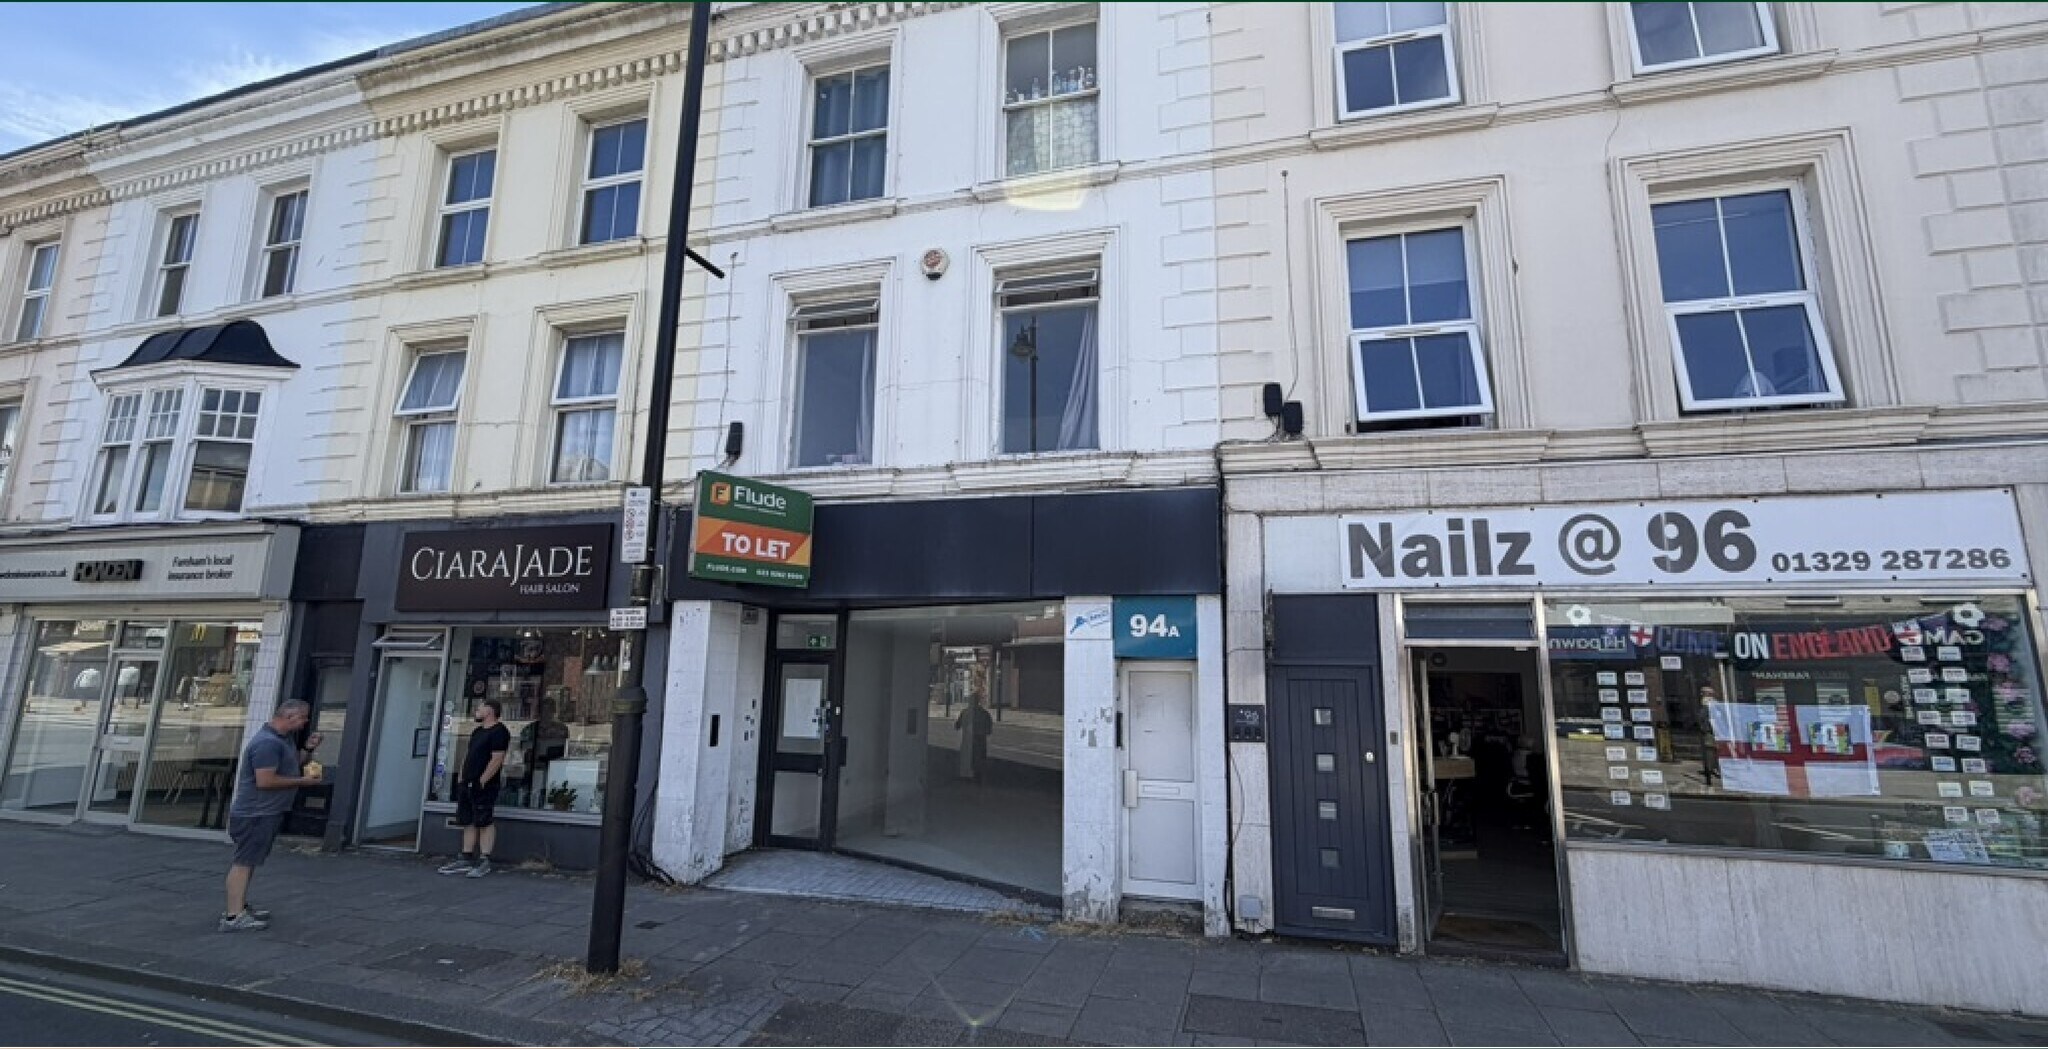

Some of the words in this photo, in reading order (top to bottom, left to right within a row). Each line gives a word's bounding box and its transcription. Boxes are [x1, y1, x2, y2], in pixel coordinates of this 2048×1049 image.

[734, 486, 787, 509] Flude
[722, 532, 751, 554] TO
[756, 538, 790, 560] LET
[1348, 518, 1536, 579] Nailz
[1558, 513, 1621, 576] @
[1647, 509, 1757, 573] 96
[214, 554, 235, 566] local
[1771, 551, 1871, 573] 01329
[1881, 548, 2011, 571] 287286
[168, 570, 204, 581] insurance
[205, 568, 234, 580] broker
[520, 584, 544, 595] HAIR
[545, 583, 580, 594] SALON
[1734, 632, 1769, 660] ON
[1771, 623, 1892, 661] ENGLAND
